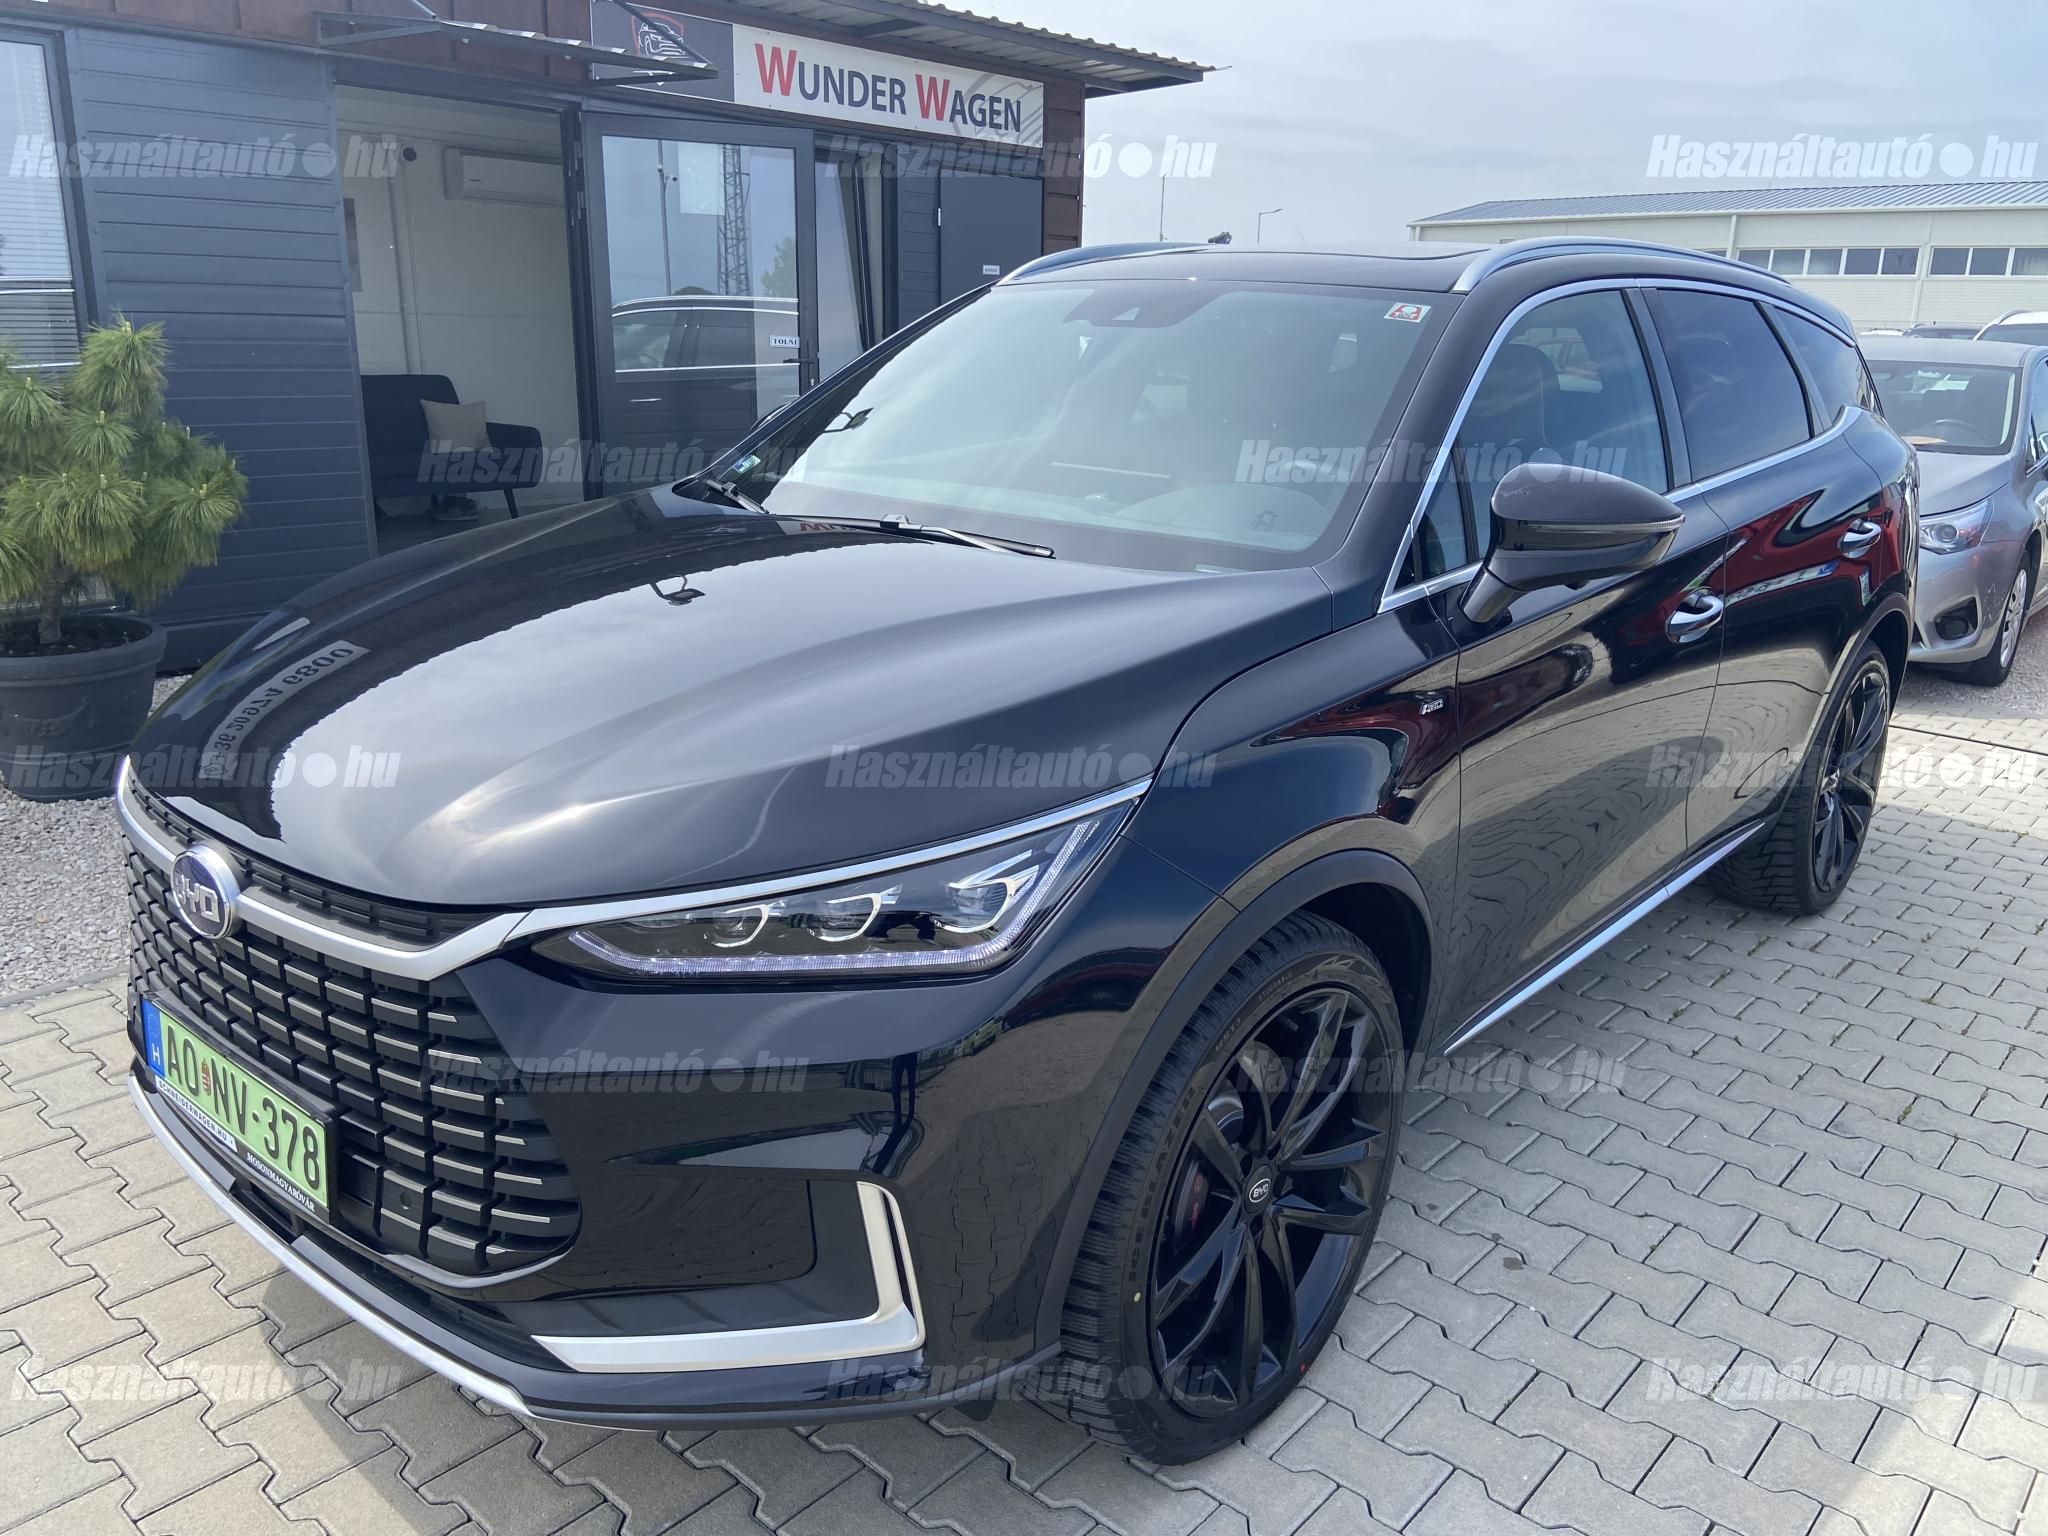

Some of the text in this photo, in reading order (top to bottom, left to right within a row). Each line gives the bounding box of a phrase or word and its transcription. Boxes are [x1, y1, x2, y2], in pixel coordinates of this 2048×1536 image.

[755, 43, 1021, 133] WUNDER WAGEN
[175, 873, 220, 922] BYD
[153, 1045, 161, 1066] H
[1252, 1183, 1269, 1198] BYD
